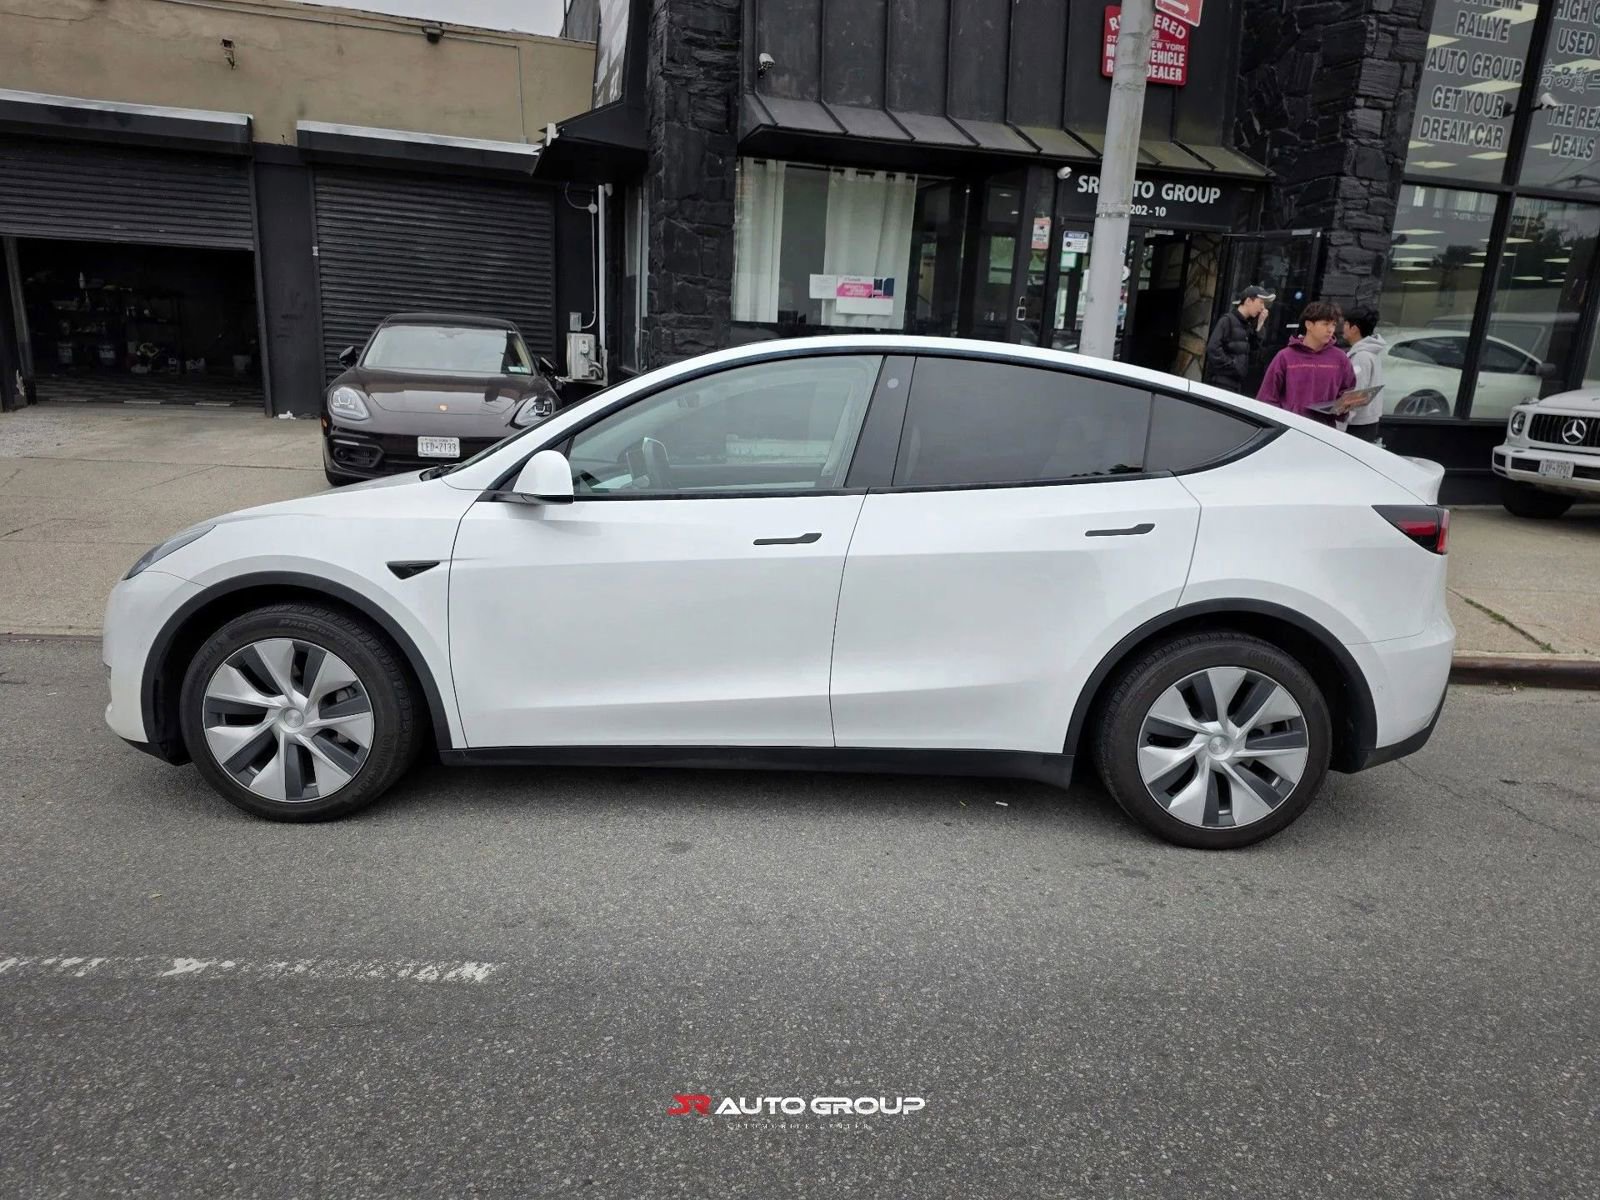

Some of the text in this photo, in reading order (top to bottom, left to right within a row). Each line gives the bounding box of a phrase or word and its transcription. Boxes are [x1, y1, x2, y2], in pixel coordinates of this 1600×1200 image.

[1554, 0, 1590, 23] HIGH
[1455, 10, 1511, 43] RALLYE
[1165, 43, 1185, 52] YORK
[1557, 27, 1596, 56] USED
[1426, 47, 1523, 82] AUTO GROUP
[1431, 84, 1504, 118] GET YOUR
[1547, 104, 1576, 128] THE
[1419, 115, 1504, 148] DREAM CAR
[1549, 132, 1595, 160] DEALS
[1077, 175, 1100, 194] SR
[1161, 183, 1221, 204] GROUP
